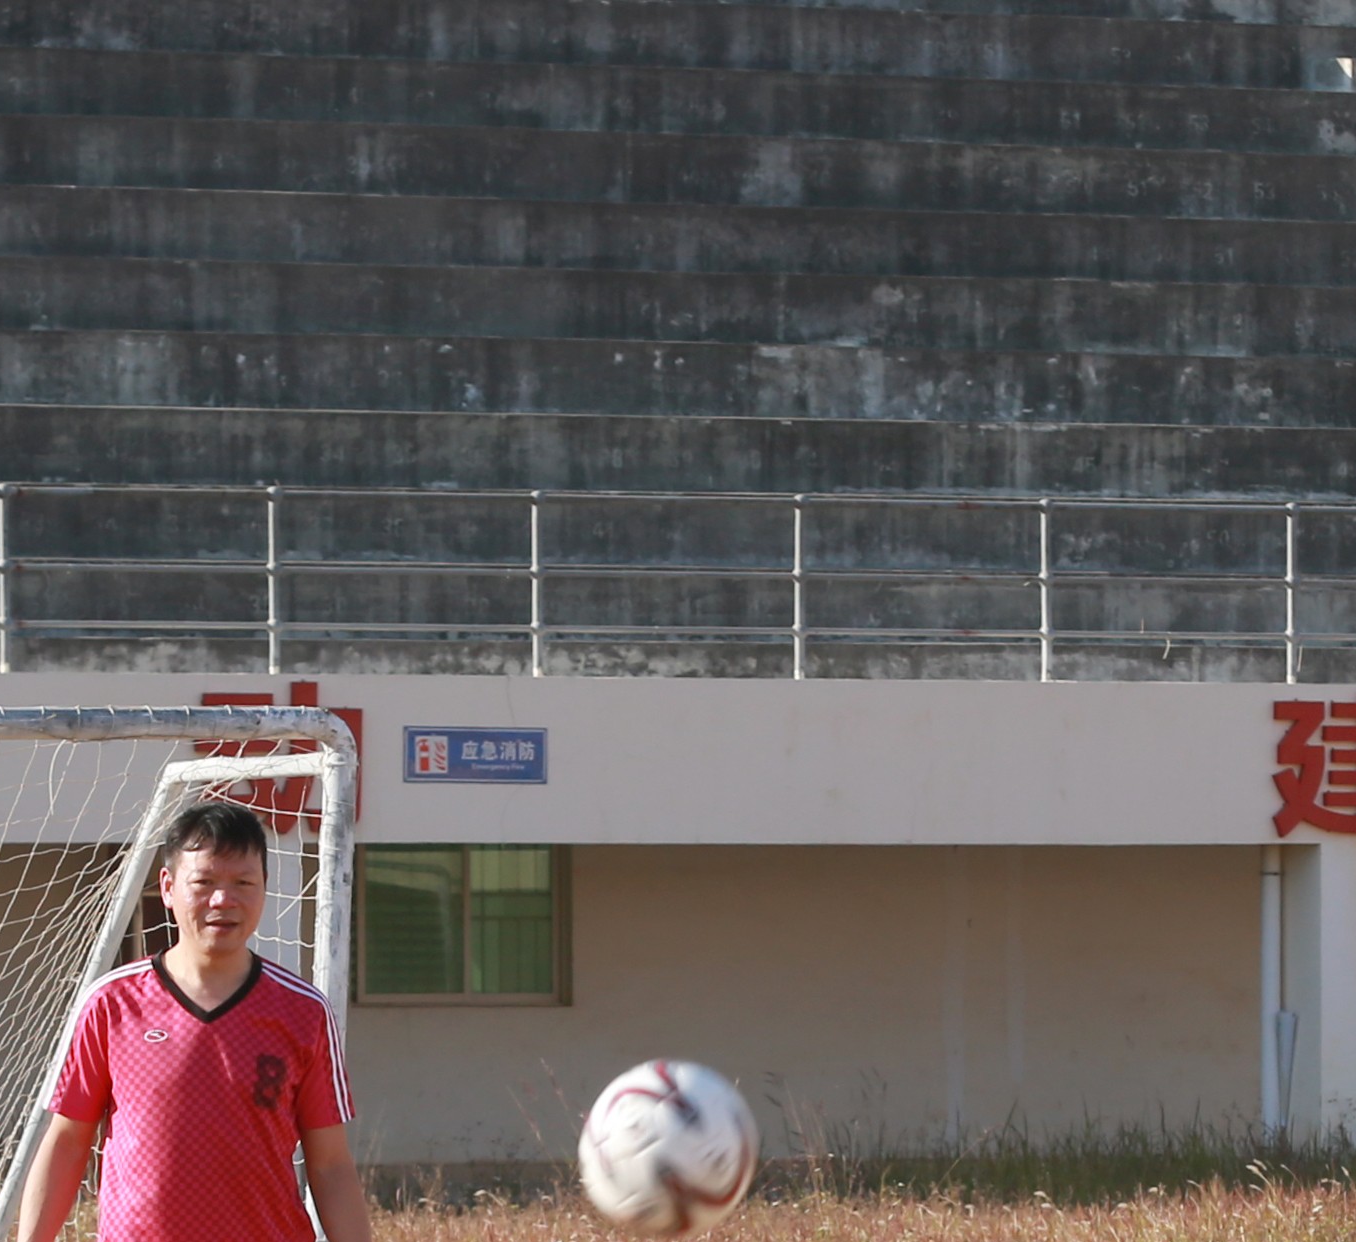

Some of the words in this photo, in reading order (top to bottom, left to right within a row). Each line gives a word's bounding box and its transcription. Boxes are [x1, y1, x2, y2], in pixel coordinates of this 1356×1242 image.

[461, 740, 536, 761] 应急消防
[253, 1053, 288, 1110] 8
